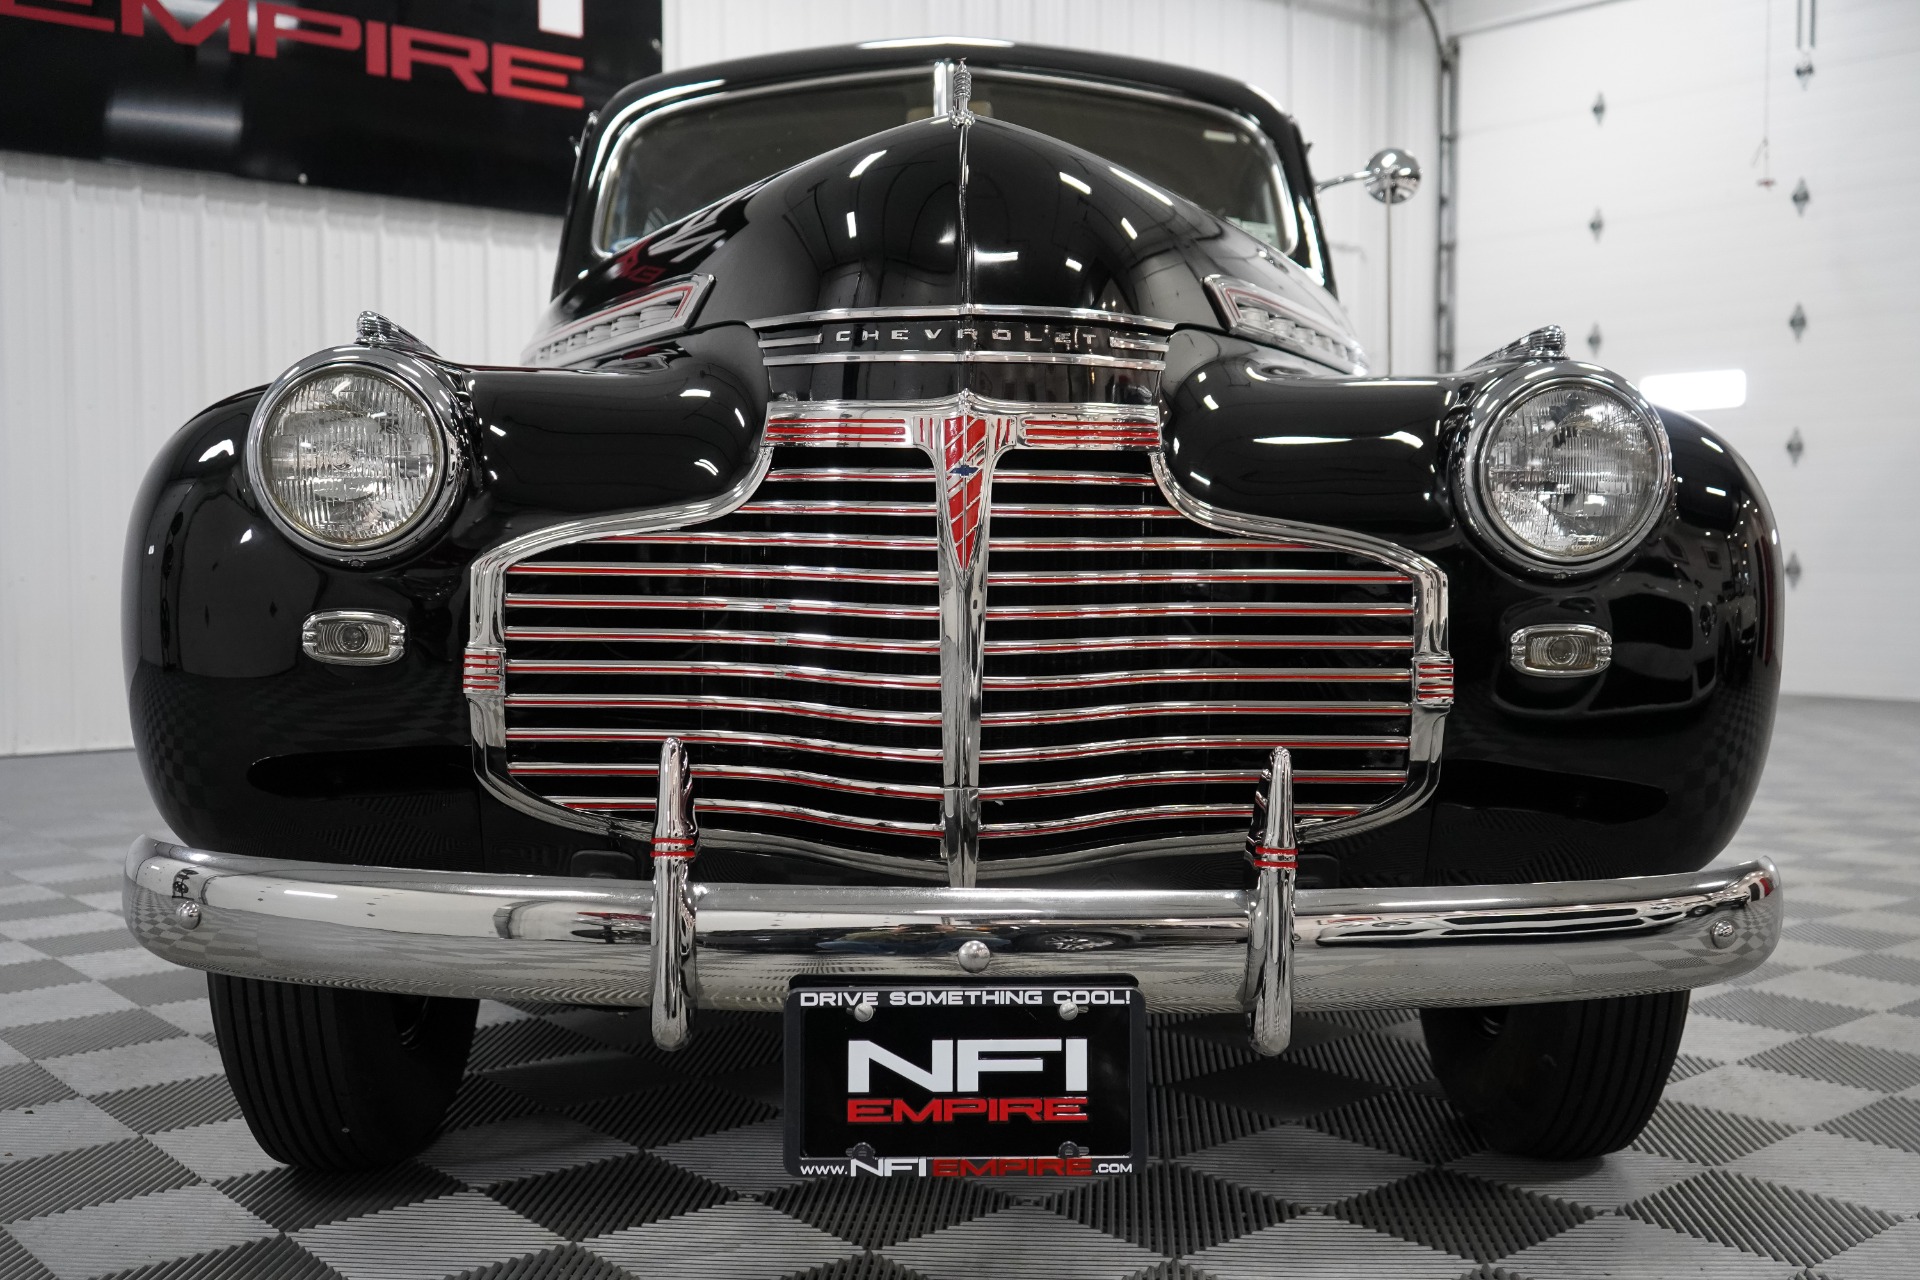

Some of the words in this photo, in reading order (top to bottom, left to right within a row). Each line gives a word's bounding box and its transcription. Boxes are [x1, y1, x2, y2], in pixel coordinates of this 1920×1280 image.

[835, 327, 1096, 346] CHEVROLET
[800, 992, 879, 1007] DRIVE
[889, 991, 1043, 1006] SOMETHING
[1053, 990, 1131, 1005] COOL!
[847, 1097, 1088, 1123] EMPIRE
